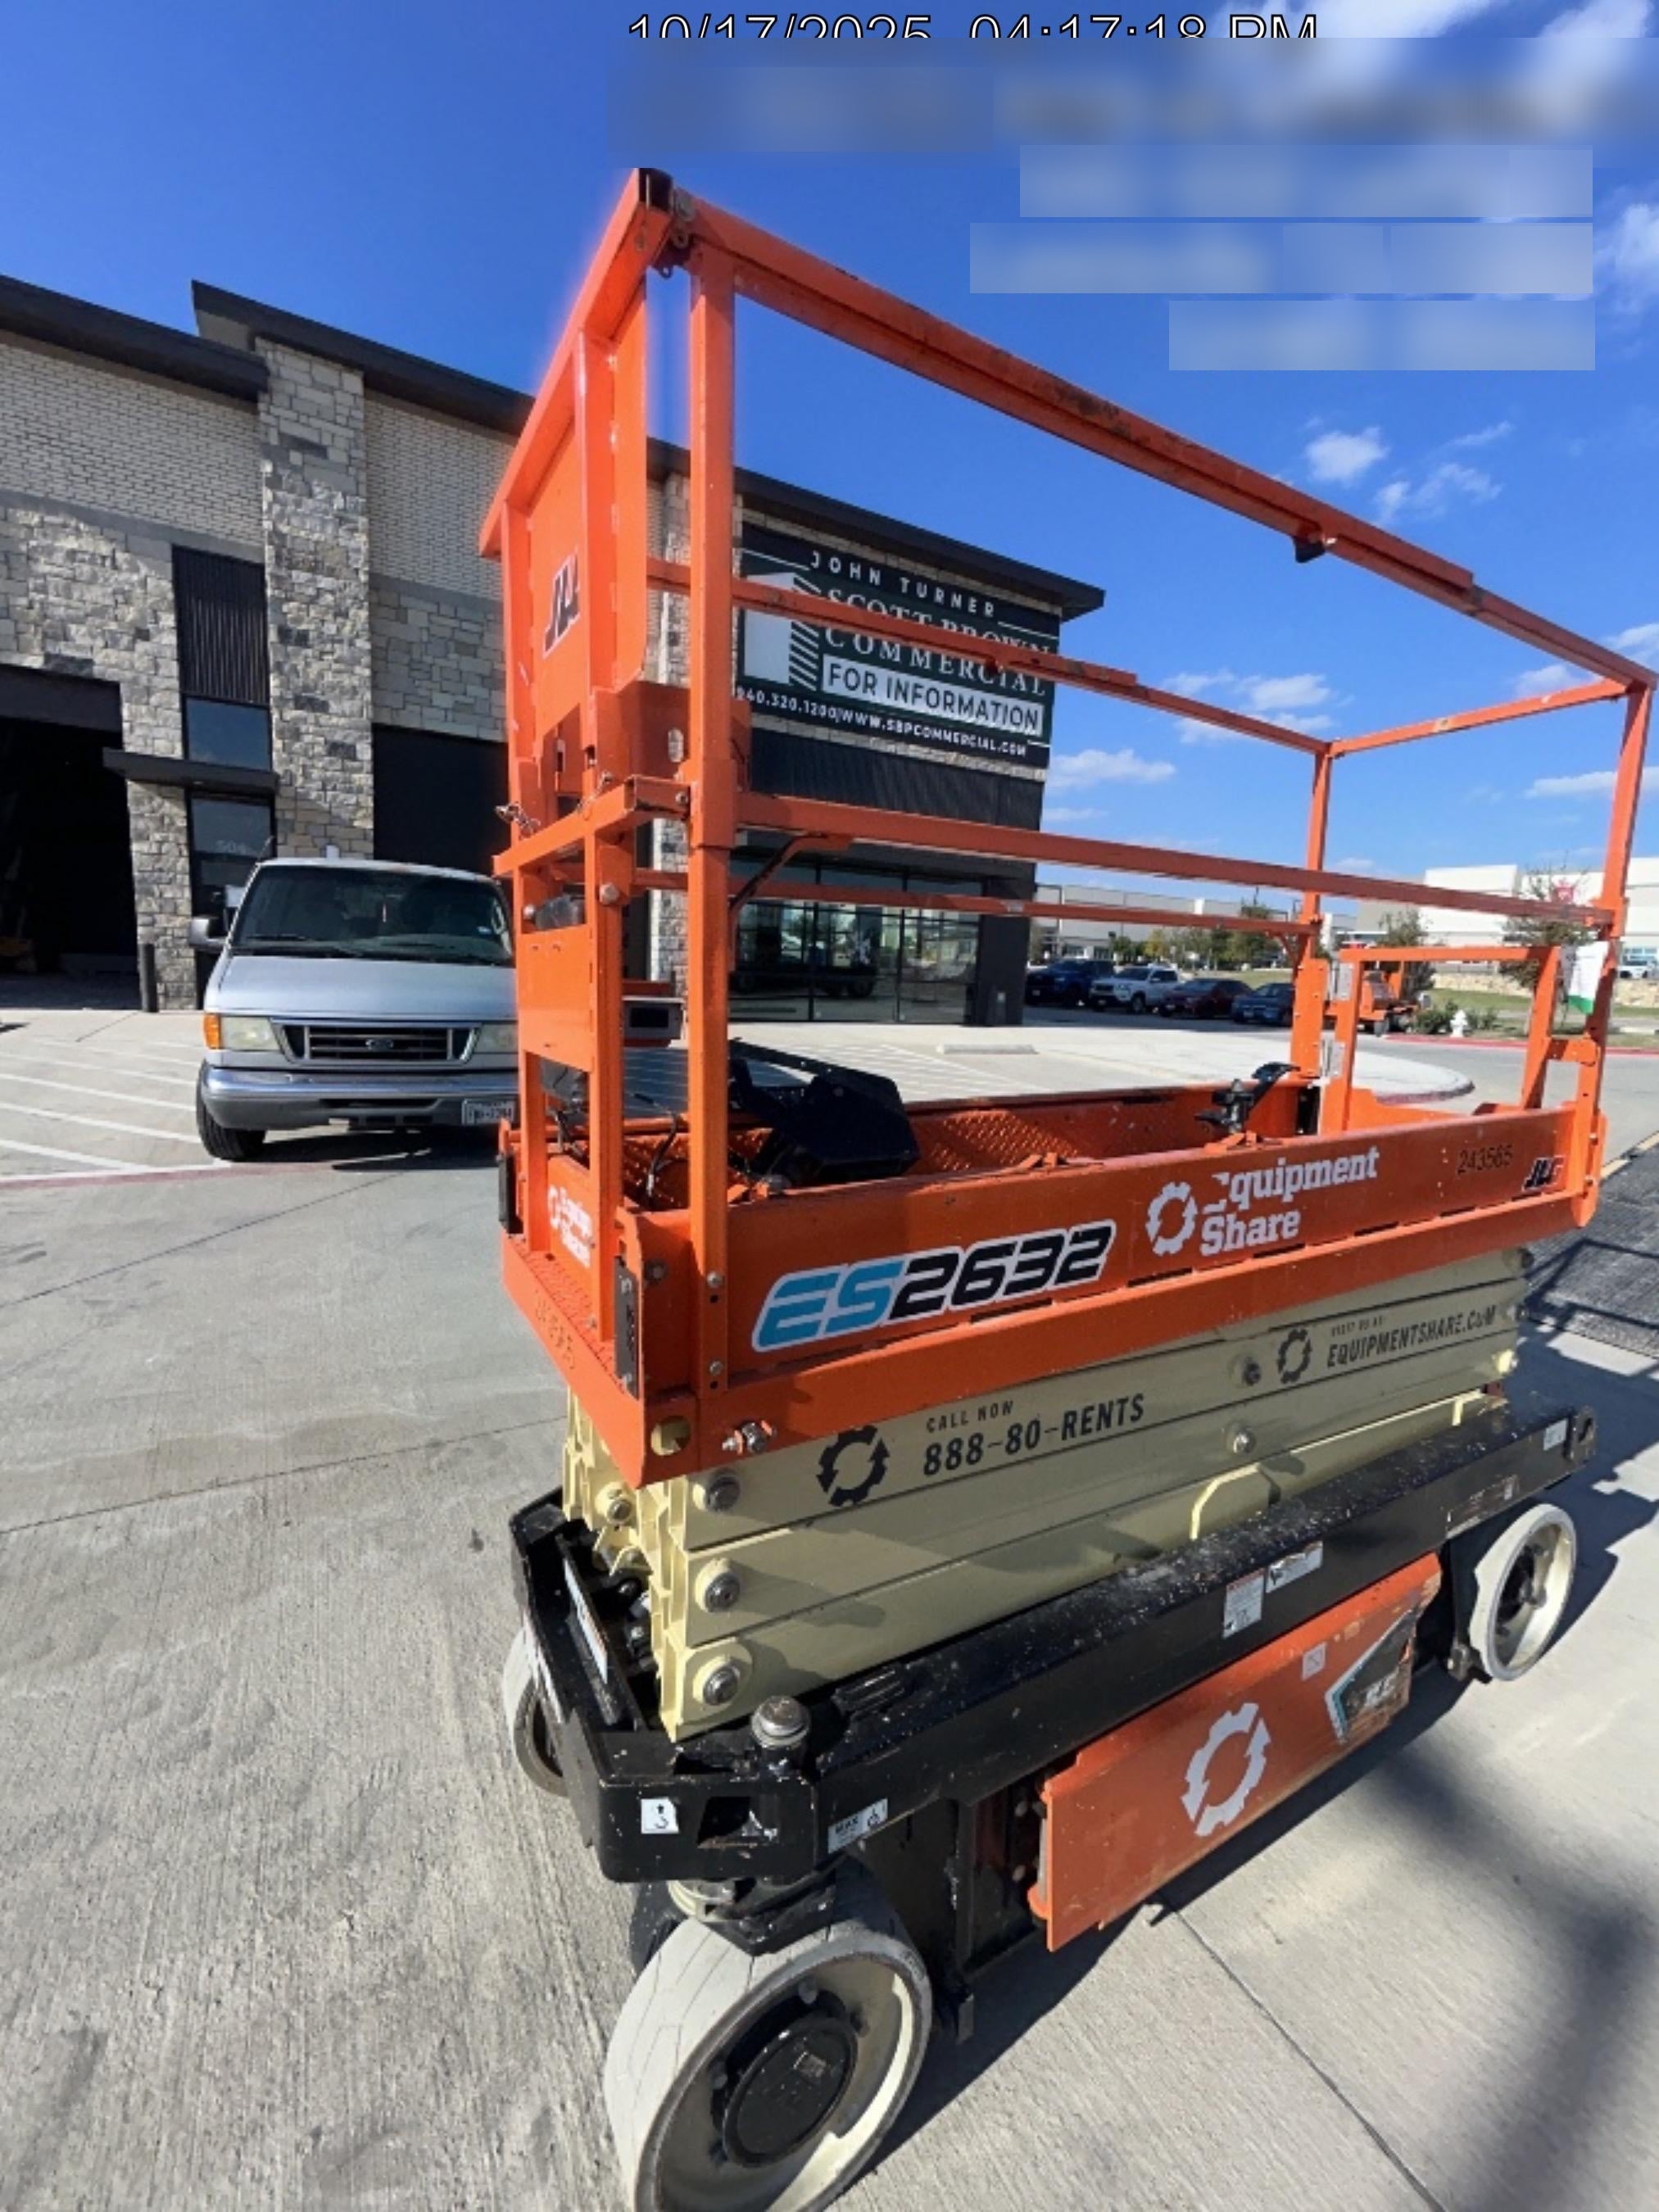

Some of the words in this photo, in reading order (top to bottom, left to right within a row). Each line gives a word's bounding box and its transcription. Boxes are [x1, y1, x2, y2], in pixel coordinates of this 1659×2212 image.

[809, 551, 881, 586] JOHN
[900, 578, 995, 618] TURNER
[827, 663, 877, 696] FOR
[886, 674, 1039, 731] INFORMATION
[1199, 1210, 1301, 1257] Share
[752, 1219, 1117, 1353] ES2632
[1326, 1304, 1497, 1368] EQUIPMENTSHARE.COM
[923, 1393, 1145, 1475] 888-80-RENTS
[927, 1410, 968, 1433] CALL
[977, 1400, 1013, 1421] NOW
